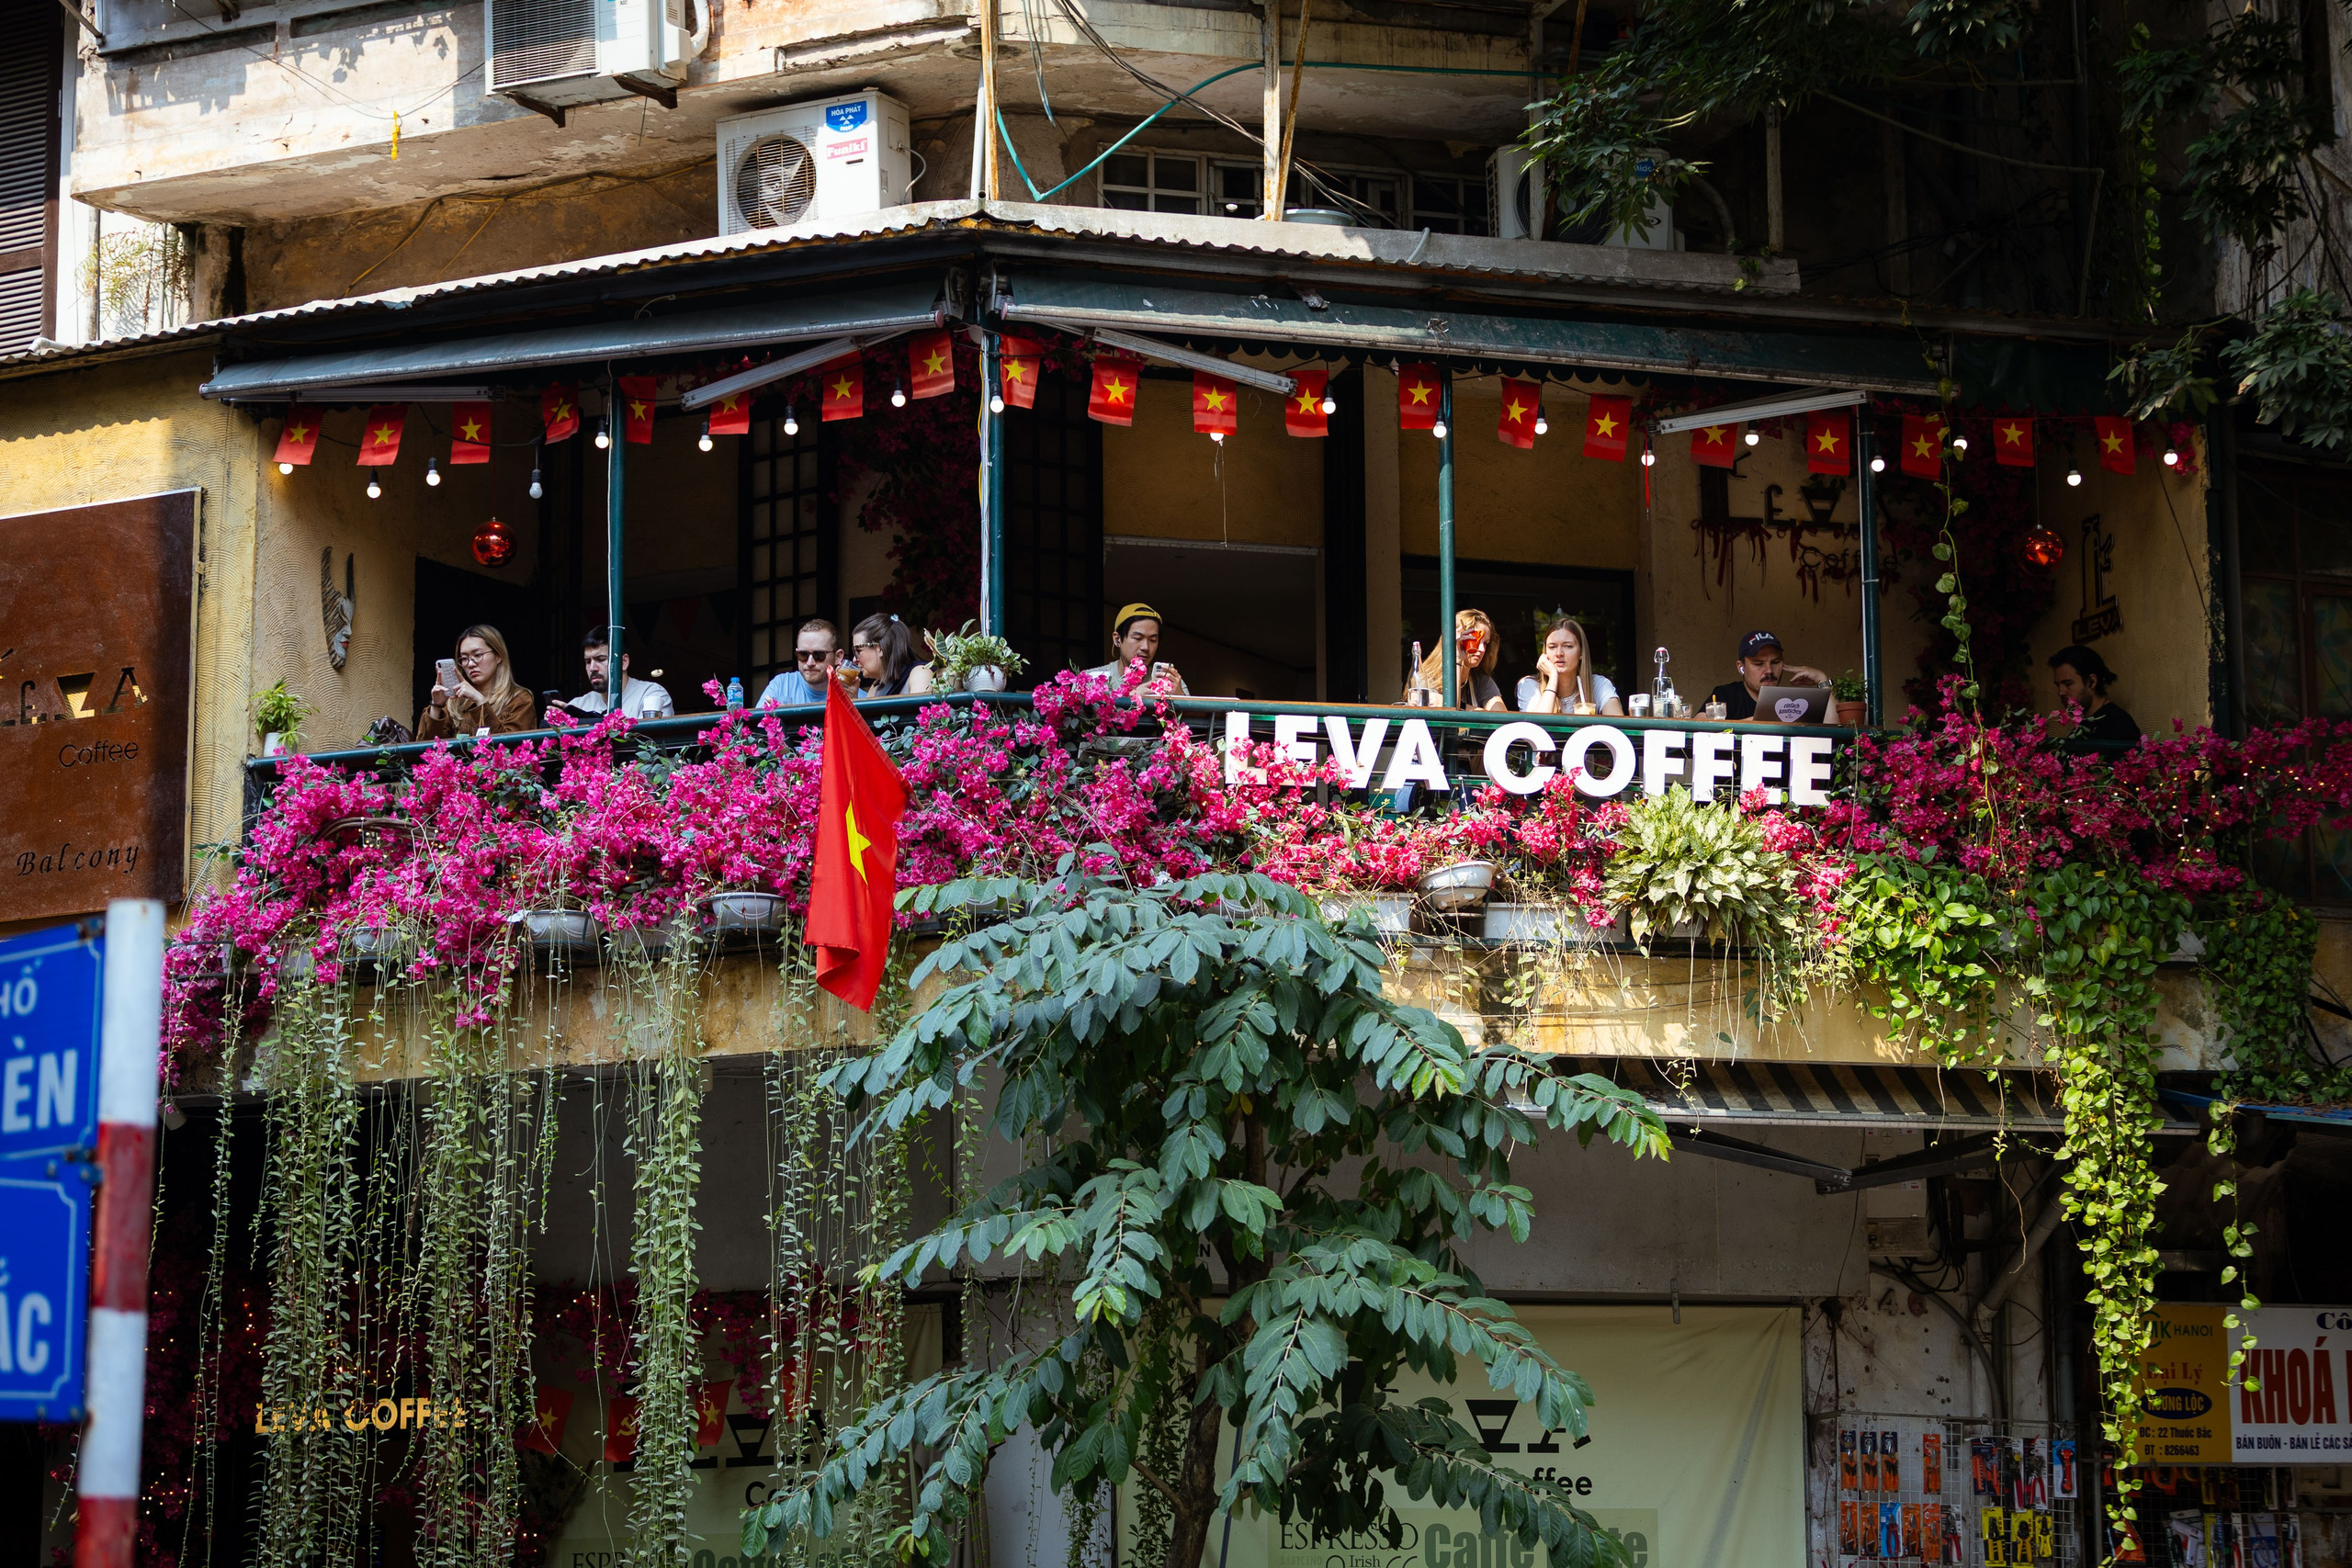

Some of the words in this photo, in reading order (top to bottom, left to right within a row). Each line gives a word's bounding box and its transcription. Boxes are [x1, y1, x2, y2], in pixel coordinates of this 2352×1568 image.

[827, 141, 865, 156] Funiki
[1747, 633, 1774, 645] FILA
[59, 740, 139, 768] Coffee
[1225, 711, 1449, 791] LEVA
[1484, 722, 1834, 807] COFFEE
[16, 842, 140, 876] Balcony
[2174, 1325, 2212, 1337] HANOI
[2181, 1361, 2203, 1385] Lý
[2239, 1337, 2336, 1425] KHOÁ
[2186, 1393, 2205, 1415] LỘC
[2158, 1427, 2168, 1438] 22
[2236, 1434, 2254, 1450] BÁN
[2257, 1434, 2281, 1450] BUÔN
[2290, 1434, 2308, 1450] BÁN
[2323, 1434, 2341, 1450] CÁC
[1350, 1555, 1380, 1567] Irish
